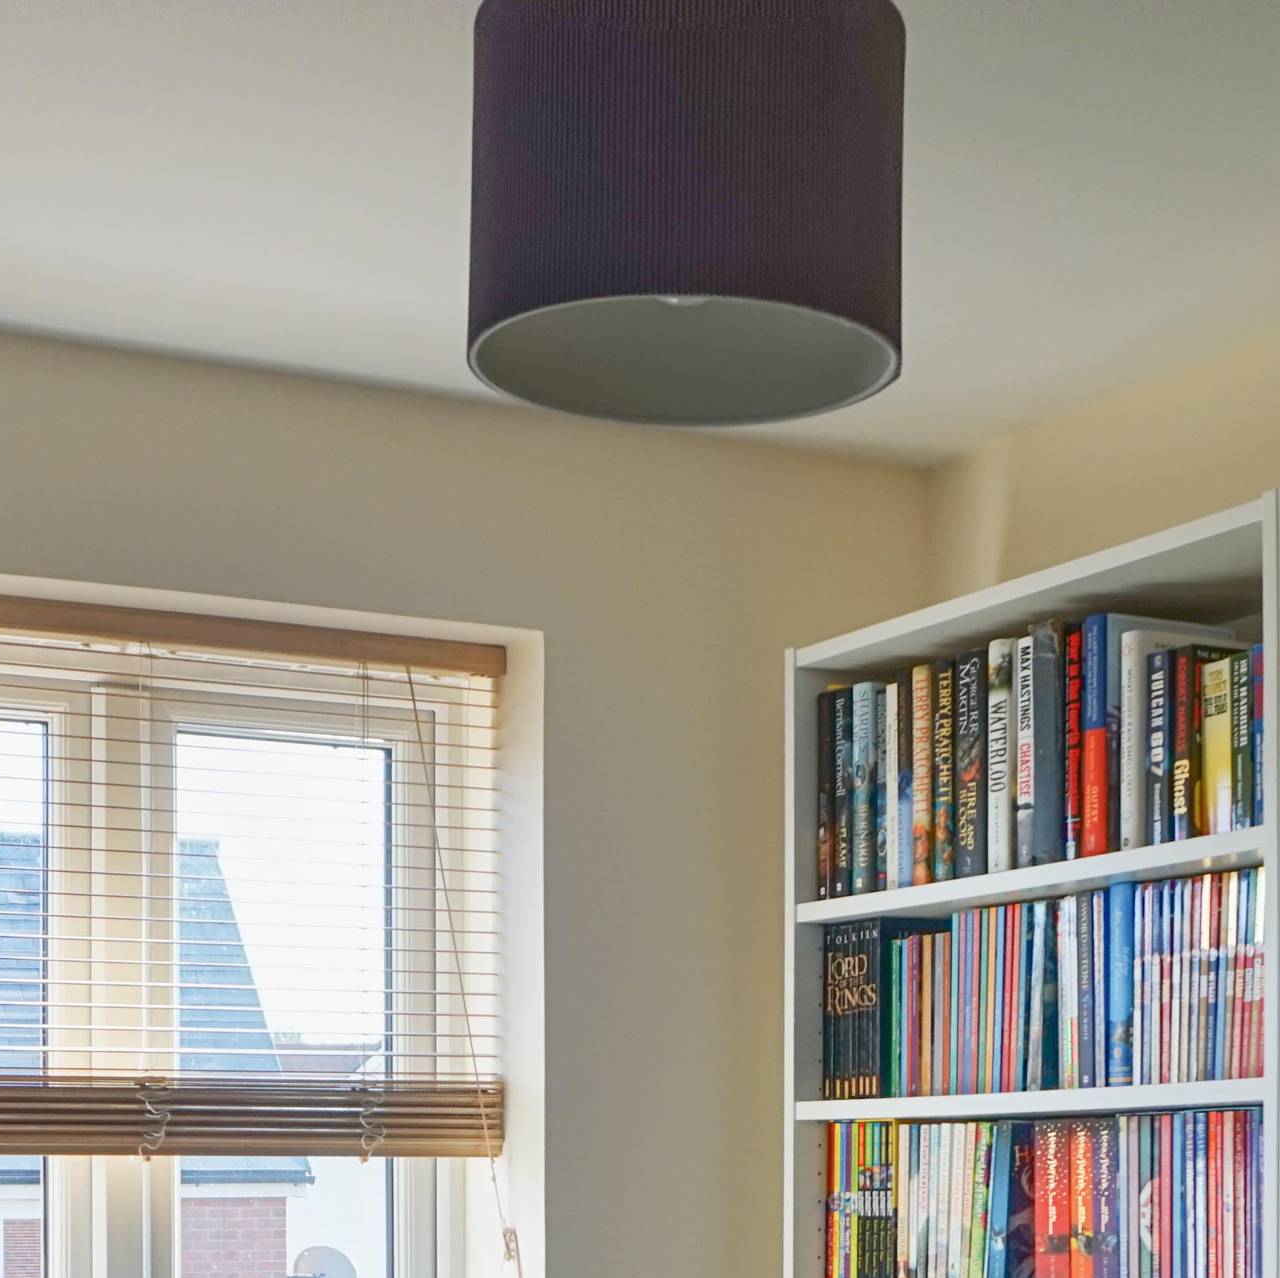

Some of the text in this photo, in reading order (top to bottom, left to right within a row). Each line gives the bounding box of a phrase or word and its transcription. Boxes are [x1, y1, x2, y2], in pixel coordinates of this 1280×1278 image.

[959, 664, 970, 734] MARTIN
[1019, 645, 1031, 731] MAX HASTINGS
[1239, 659, 1248, 683] SEA
[939, 669, 953, 801] TERRY PRATCHETT
[990, 699, 1007, 793] WATERLOO
[1150, 670, 1164, 777] VULCAN 607
[1239, 686, 1248, 747] HARRIER
[1019, 743, 1031, 797] CHASTISE
[1173, 759, 1190, 817] Ghost
[959, 789, 968, 845] BLOOD
[966, 782, 977, 850] FIRE AND
[827, 984, 877, 1015] RINGS
